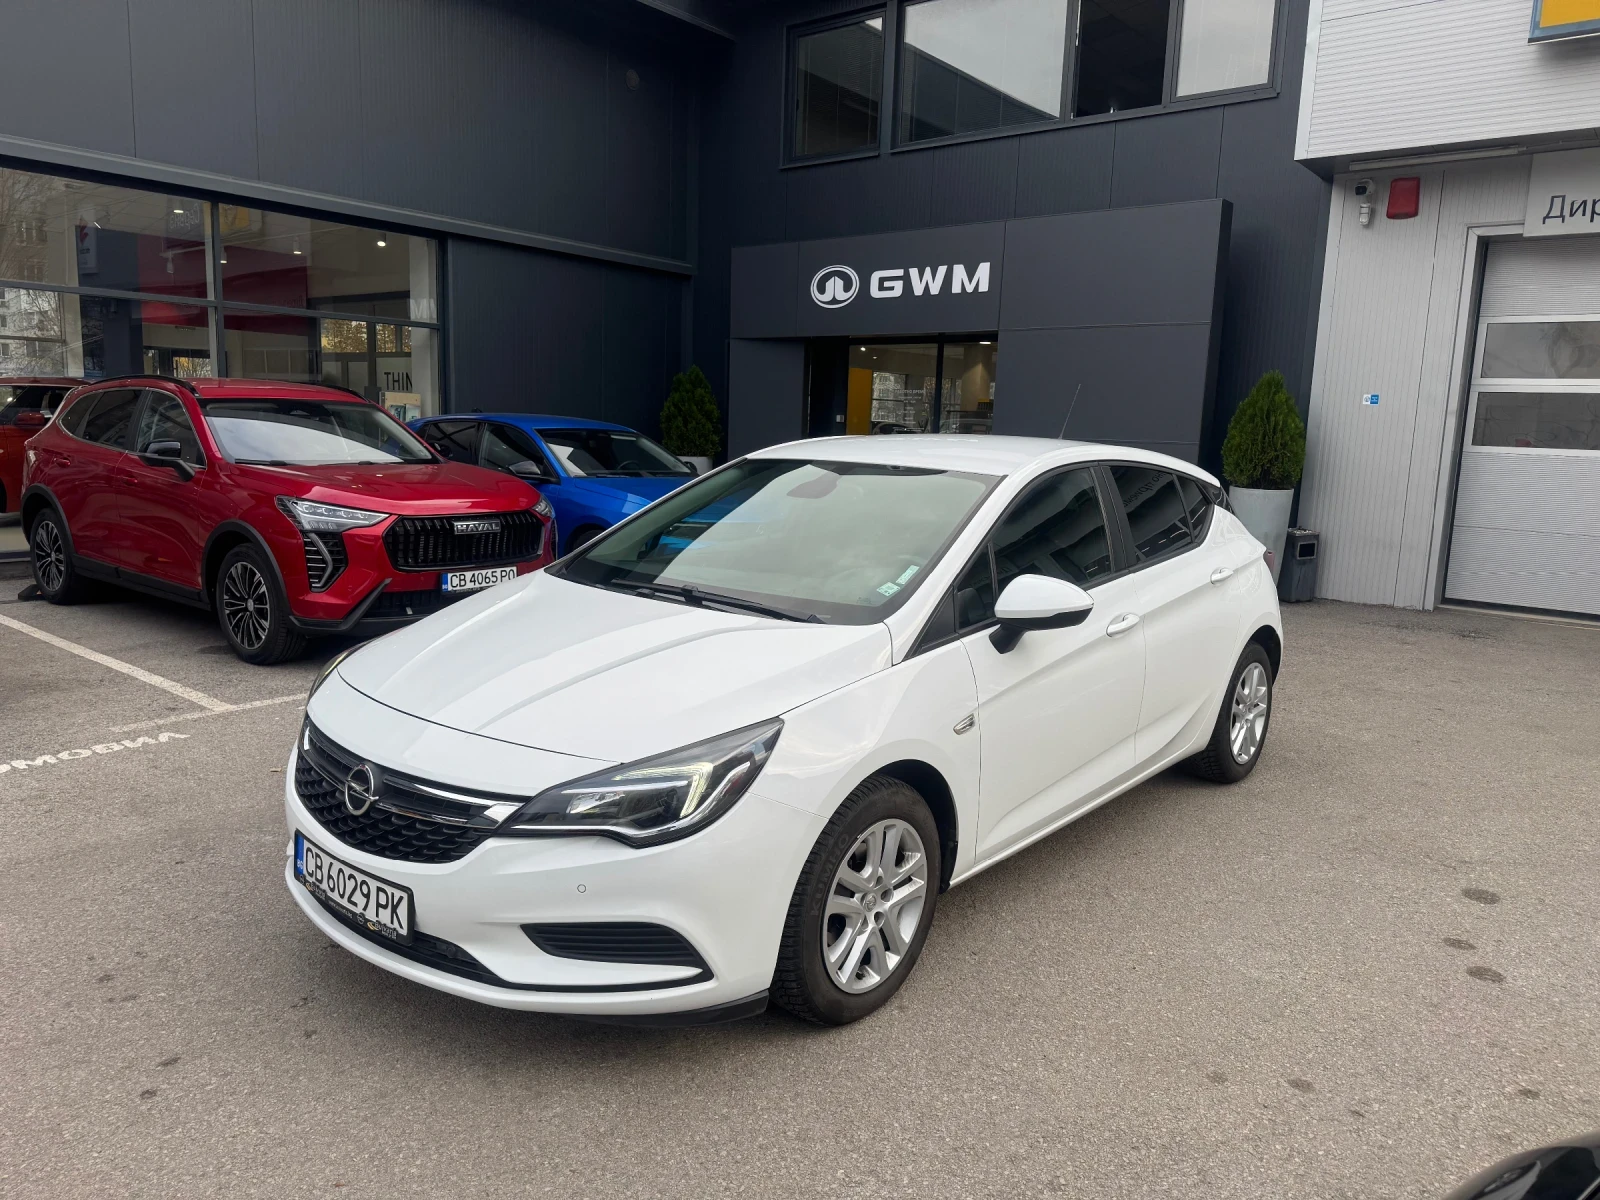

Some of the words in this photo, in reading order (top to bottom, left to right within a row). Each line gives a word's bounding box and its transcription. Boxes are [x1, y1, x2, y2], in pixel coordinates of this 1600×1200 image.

[869, 261, 991, 299] GWM
[457, 523, 500, 532] HAVAL
[450, 573, 467, 588] CB
[469, 570, 498, 586] 4065
[305, 846, 324, 885] CB
[327, 861, 371, 912] 6029
[375, 885, 404, 930] PK
